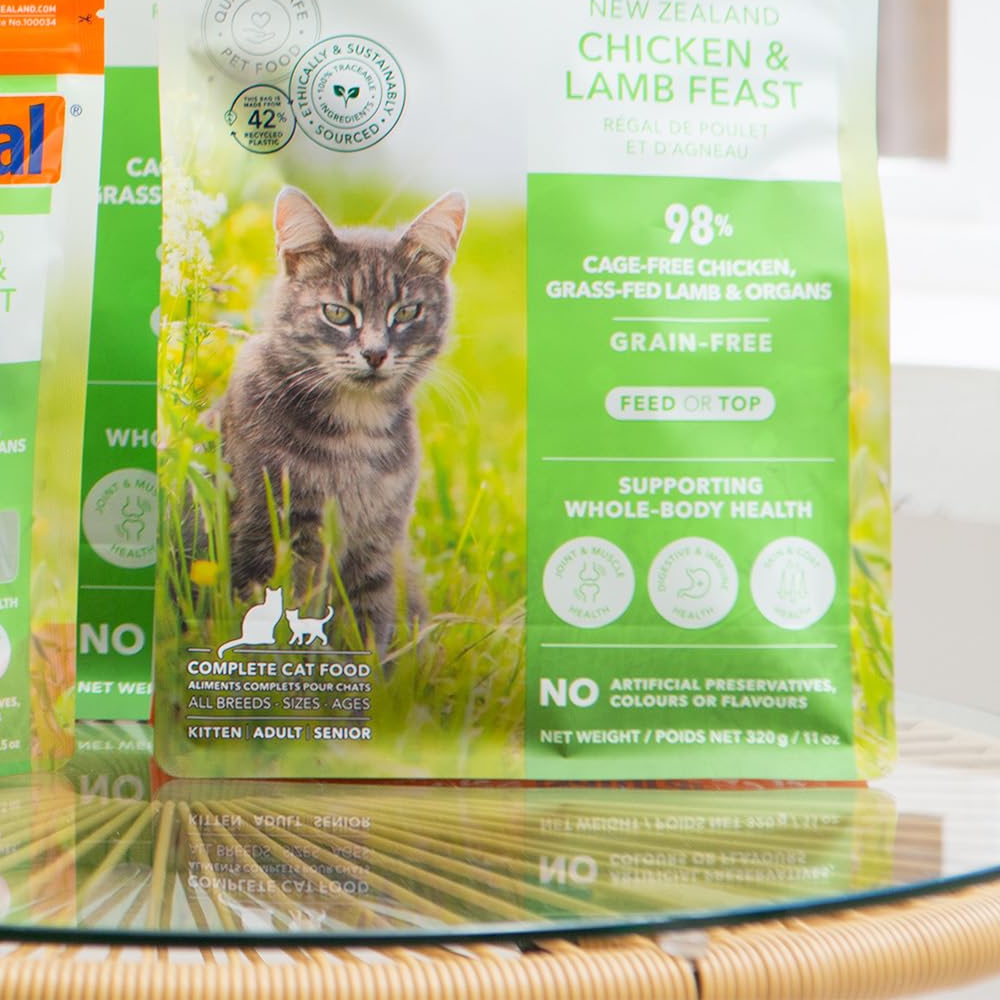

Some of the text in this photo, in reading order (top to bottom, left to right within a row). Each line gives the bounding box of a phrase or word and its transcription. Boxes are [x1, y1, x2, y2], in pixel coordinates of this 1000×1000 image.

[658, 1, 780, 26] ZEALAND
[221, 47, 247, 72] PET
[578, 32, 789, 71] CHICKEN &
[297, 43, 398, 118] ETHICALLY & SUSTAINABLY
[335, 65, 377, 92] TRACEABLE
[565, 70, 803, 109] LAMB FEAST
[248, 109, 287, 129] 42%
[320, 101, 375, 123] INGREDIENTS
[315, 122, 380, 144] SOURCED
[664, 202, 733, 246] 98%
[583, 256, 796, 278] CAGE-FREE CHICKEN,
[546, 281, 832, 300] GRASS-FED LAMB & ORGANS
[610, 332, 772, 352] GRAIN-FREE
[620, 396, 760, 412] FEED OR TOP
[619, 477, 763, 494] SUPPORTING
[564, 500, 812, 518] WHOLE-BODY HEALTH
[80, 623, 145, 655] NO
[187, 661, 371, 677] COMPLETE CAT FOOD
[77, 681, 112, 694] NET
[540, 678, 600, 707] NO
[610, 679, 837, 693] ARTIFICIAL PRESERVATIVES,
[188, 697, 370, 710] ALL BREEDS SIZES AGES
[610, 695, 808, 708] COLOURS OR FLAVOURS
[188, 726, 371, 739] KITTEN ADULT SENIOR
